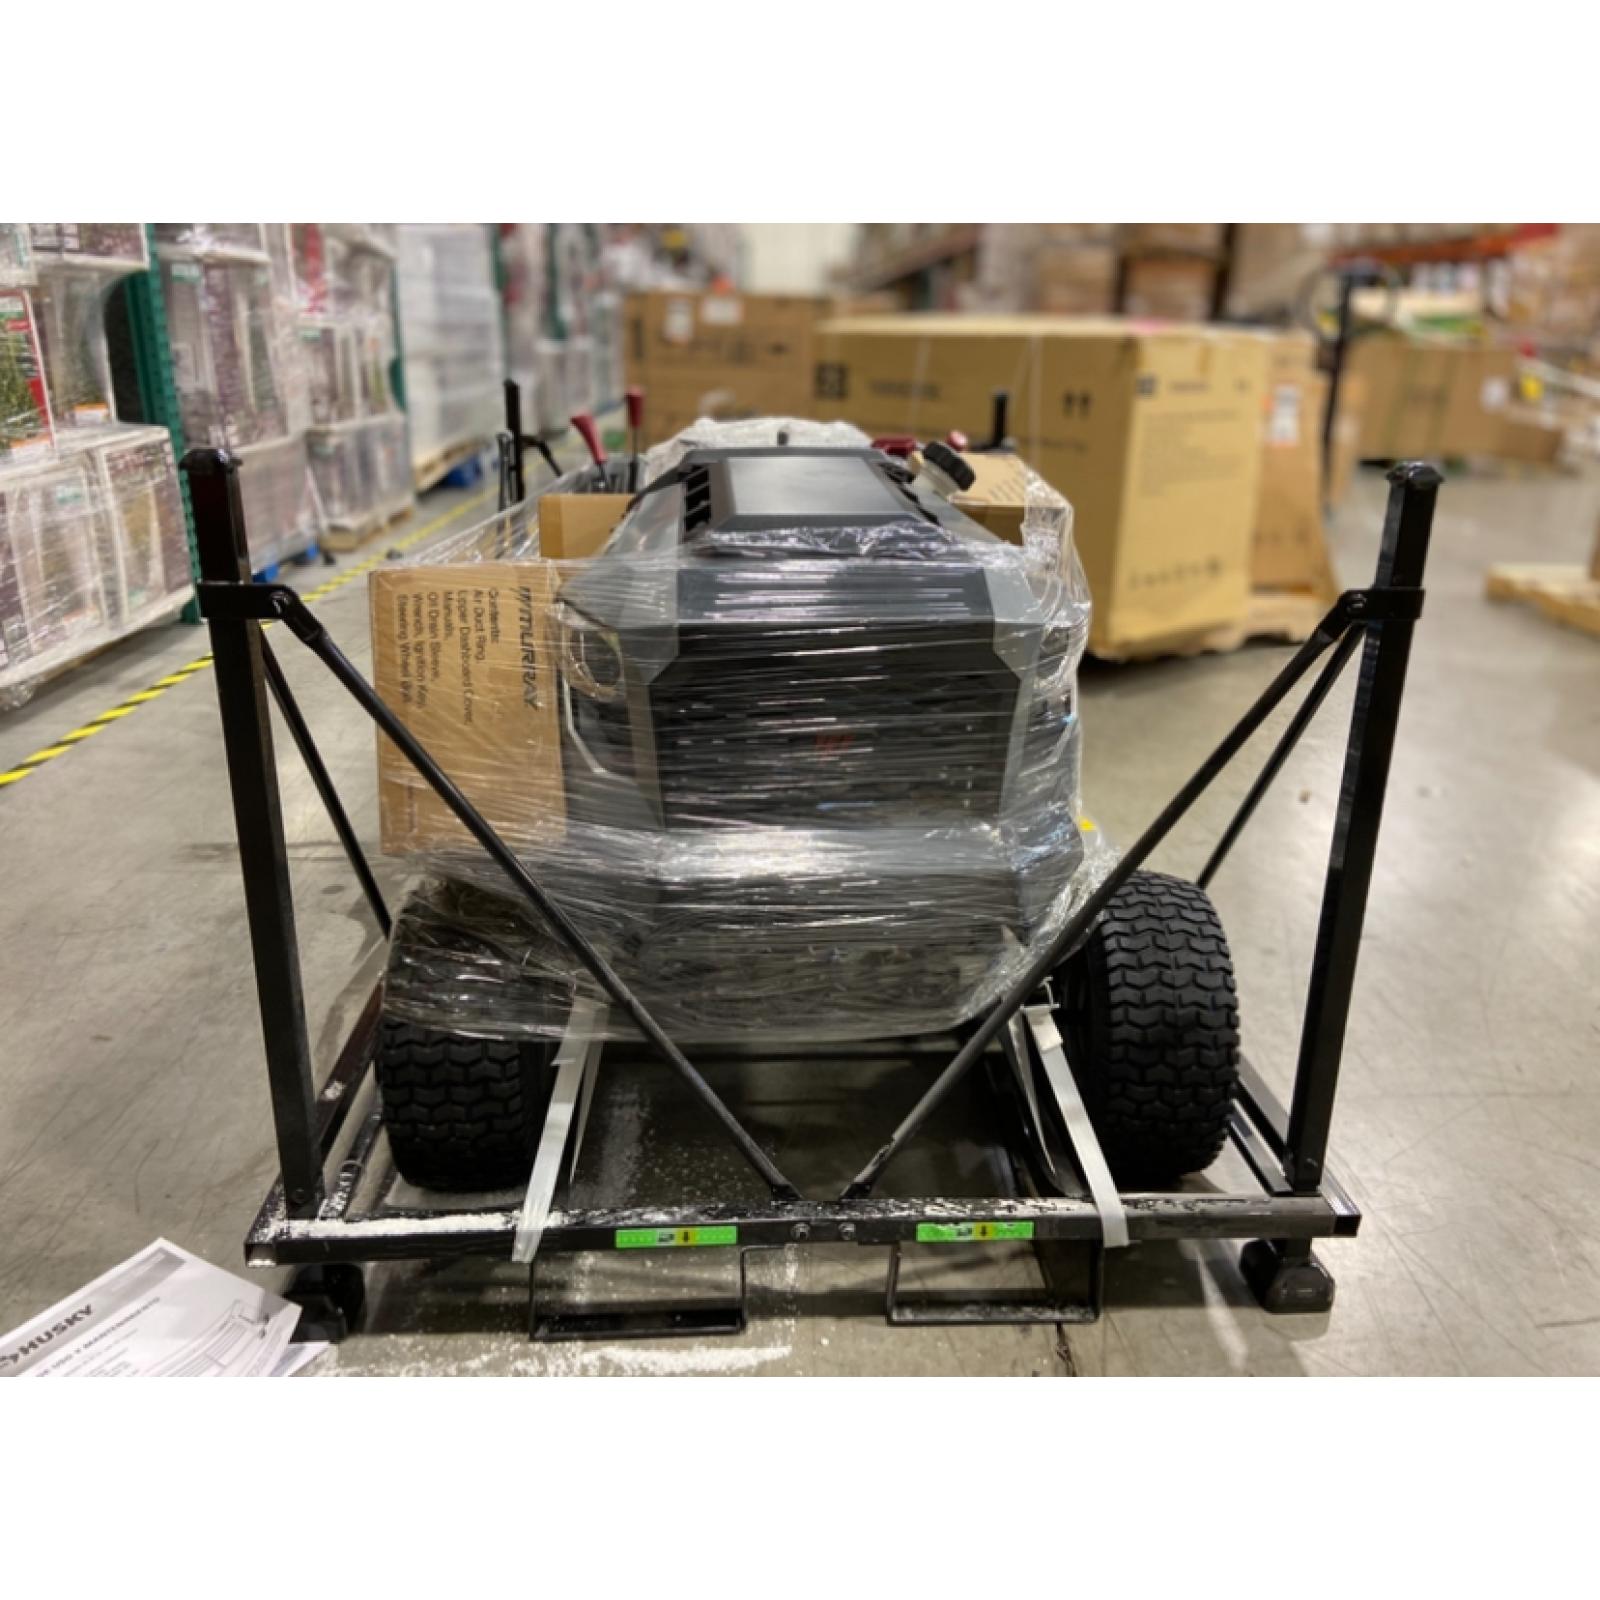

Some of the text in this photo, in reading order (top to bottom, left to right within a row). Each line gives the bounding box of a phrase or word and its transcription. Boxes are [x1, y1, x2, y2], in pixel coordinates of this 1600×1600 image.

[429, 609, 439, 639] Drain
[474, 607, 485, 631] Duct
[460, 626, 472, 687] Dashboard
[517, 601, 538, 711] MURRAY
[18, 1304, 92, 1355] HUSKY
